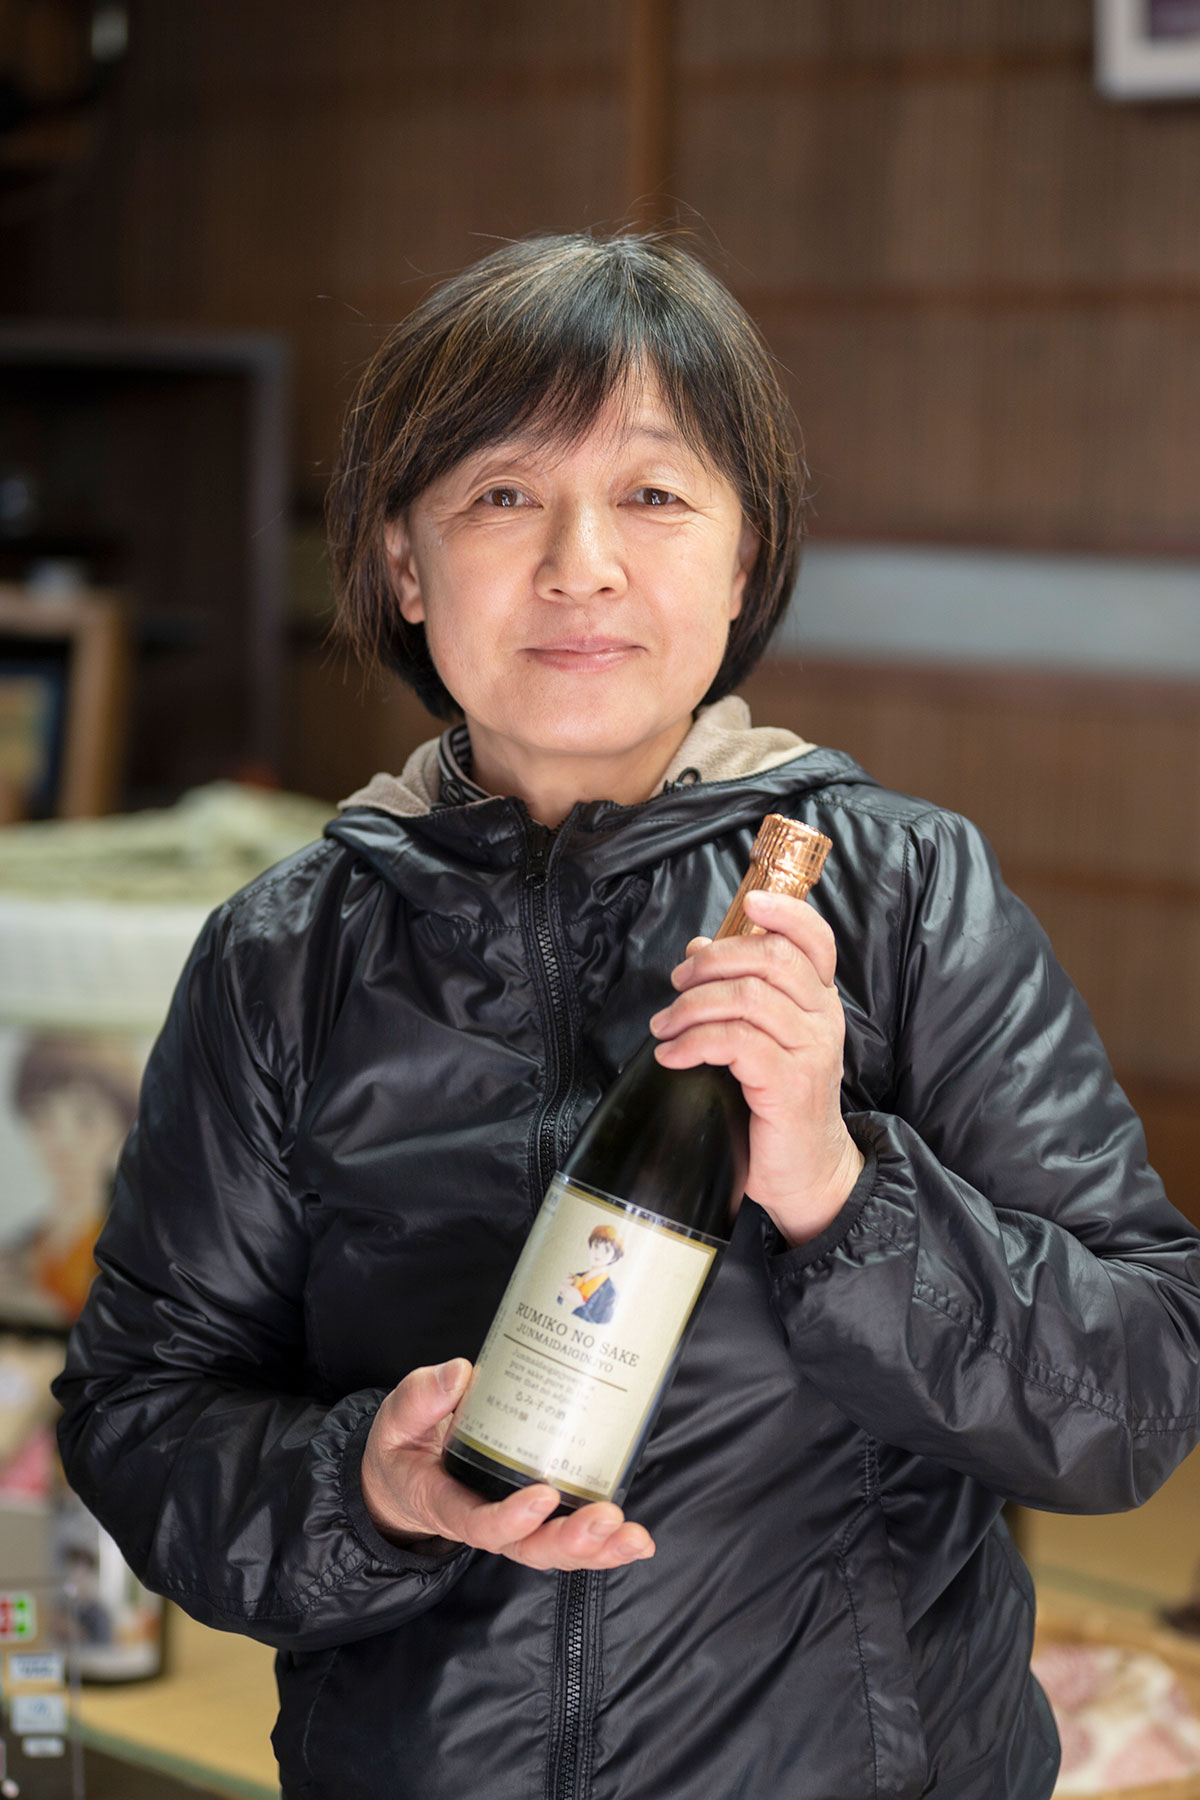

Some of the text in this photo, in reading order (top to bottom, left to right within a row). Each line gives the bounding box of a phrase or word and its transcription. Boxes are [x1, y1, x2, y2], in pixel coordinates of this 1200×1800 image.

[514, 1302, 641, 1368] RUMIKO NO SAKE
